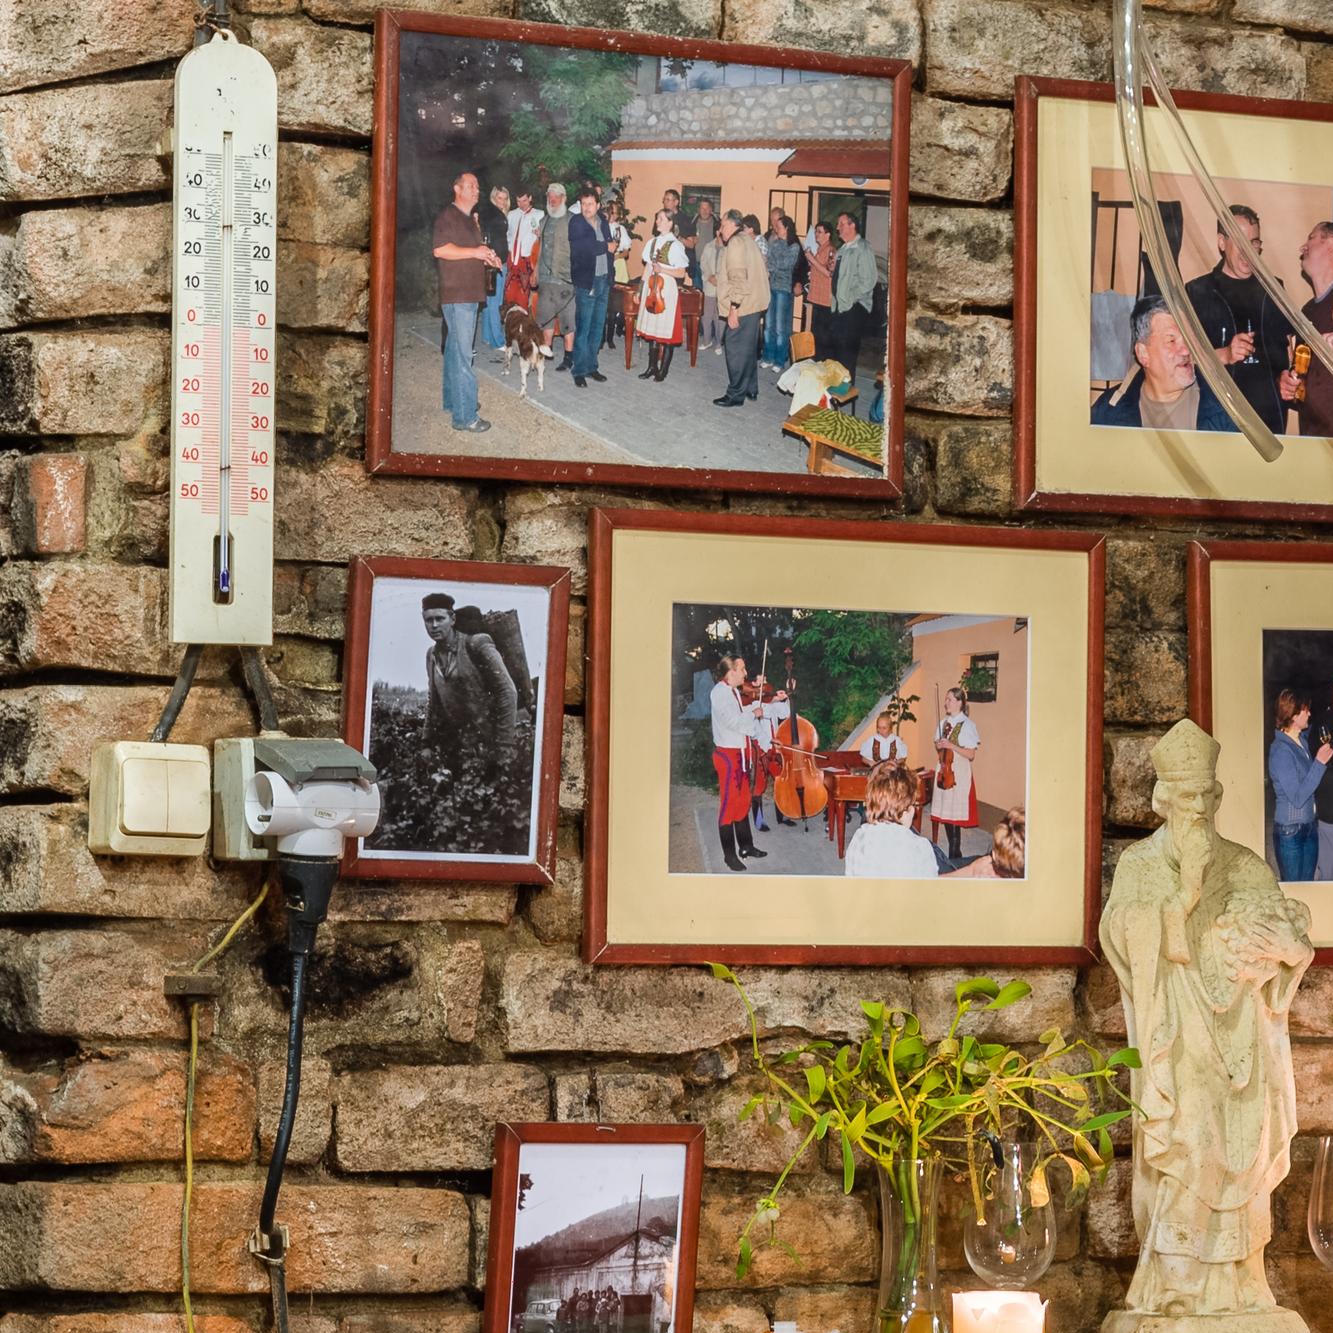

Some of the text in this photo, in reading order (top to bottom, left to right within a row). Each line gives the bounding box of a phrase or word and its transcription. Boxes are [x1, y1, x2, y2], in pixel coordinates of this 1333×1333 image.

[184, 241, 201, 254] 20
[253, 245, 270, 259] 20
[184, 275, 200, 288] 10
[254, 280, 269, 292] 10
[187, 309, 196, 322] 0
[257, 313, 266, 326] 0
[184, 344, 200, 357] 10
[253, 348, 268, 361] 10
[182, 378, 200, 391] 20
[251, 382, 269, 395] 20
[181, 412, 200, 426] 30
[251, 416, 269, 429] 30
[181, 447, 199, 460] 40
[251, 451, 268, 464] 40
[181, 484, 199, 497] 50
[250, 487, 268, 500] 50
